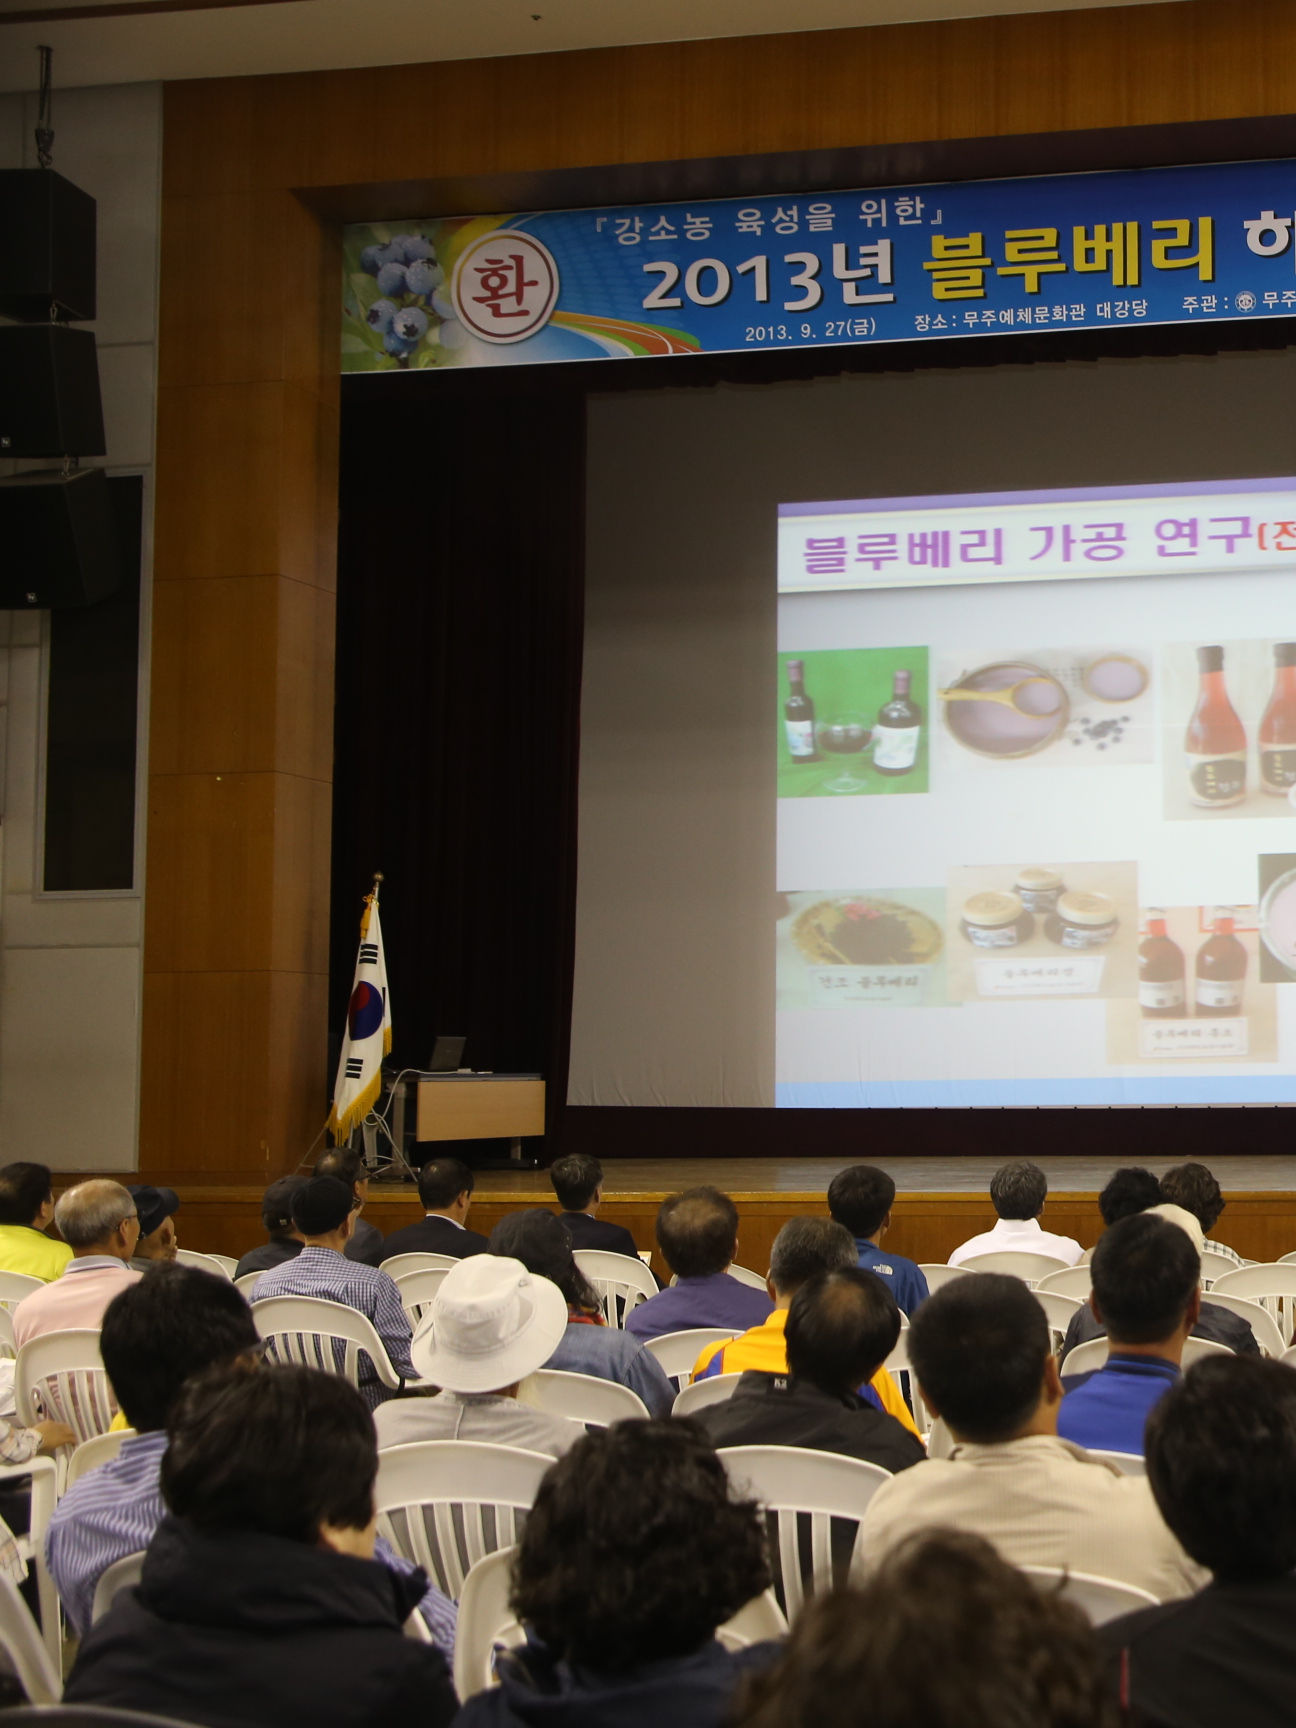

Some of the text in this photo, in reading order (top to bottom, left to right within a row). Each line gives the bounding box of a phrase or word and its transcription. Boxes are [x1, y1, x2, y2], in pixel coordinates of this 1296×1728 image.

[735, 202, 837, 237] 육성을
[471, 254, 539, 319] 환
[641, 237, 896, 311] 2013년
[922, 216, 1215, 301] 블루베리
[1096, 297, 1149, 320] 대강당
[802, 526, 1003, 576] 블루베리
[1028, 521, 1128, 563] 가공
